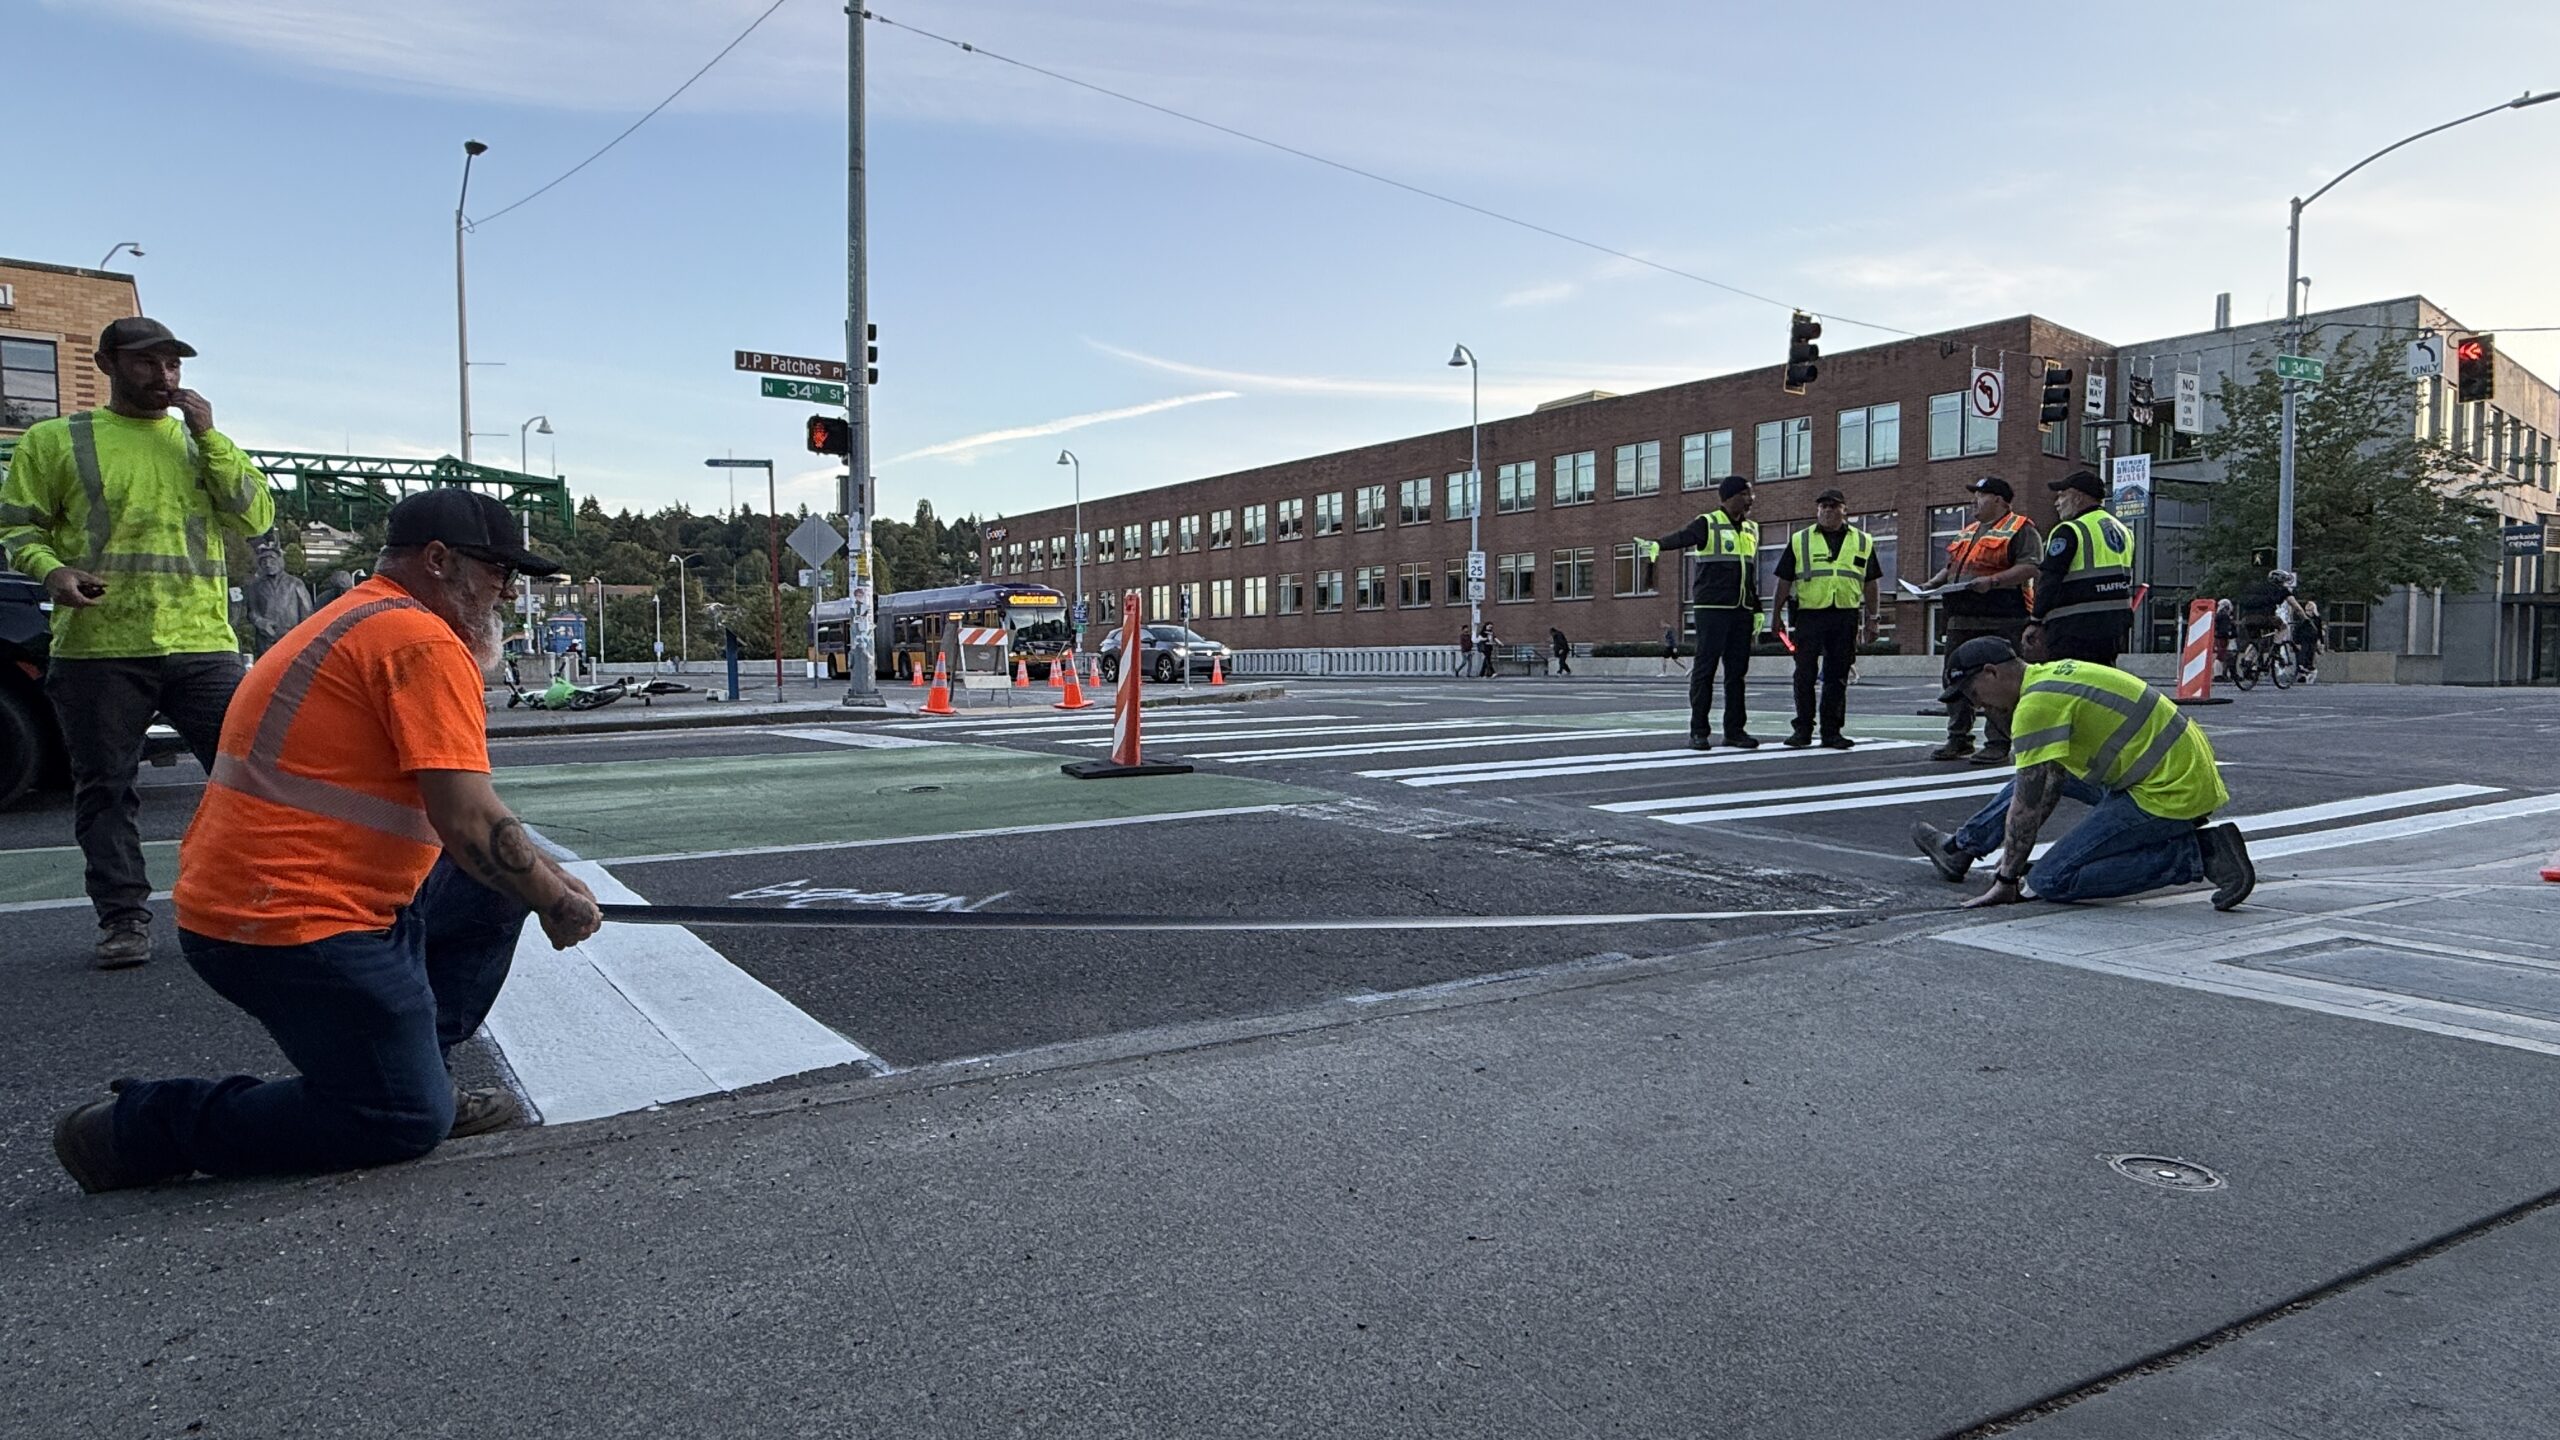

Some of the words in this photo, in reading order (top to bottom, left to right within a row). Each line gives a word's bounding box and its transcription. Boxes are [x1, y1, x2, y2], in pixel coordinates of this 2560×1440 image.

[740, 353, 763, 369] J.P.
[771, 356, 822, 375] Patches
[833, 367, 842, 377] Pl
[2411, 362, 2439, 375] ONLY
[2090, 378, 2103, 388] ONE
[2182, 379, 2195, 390] NO
[765, 382, 773, 393] N
[787, 382, 821, 398] 34th
[830, 388, 841, 399] St
[2089, 388, 2103, 397] WAY
[2183, 406, 2192, 414] ON
[2116, 465, 2146, 474] BRIDGE
[985, 526, 1007, 541] Google
[1470, 565, 1483, 576] 25
[2096, 582, 2127, 592] TRAFFIC
